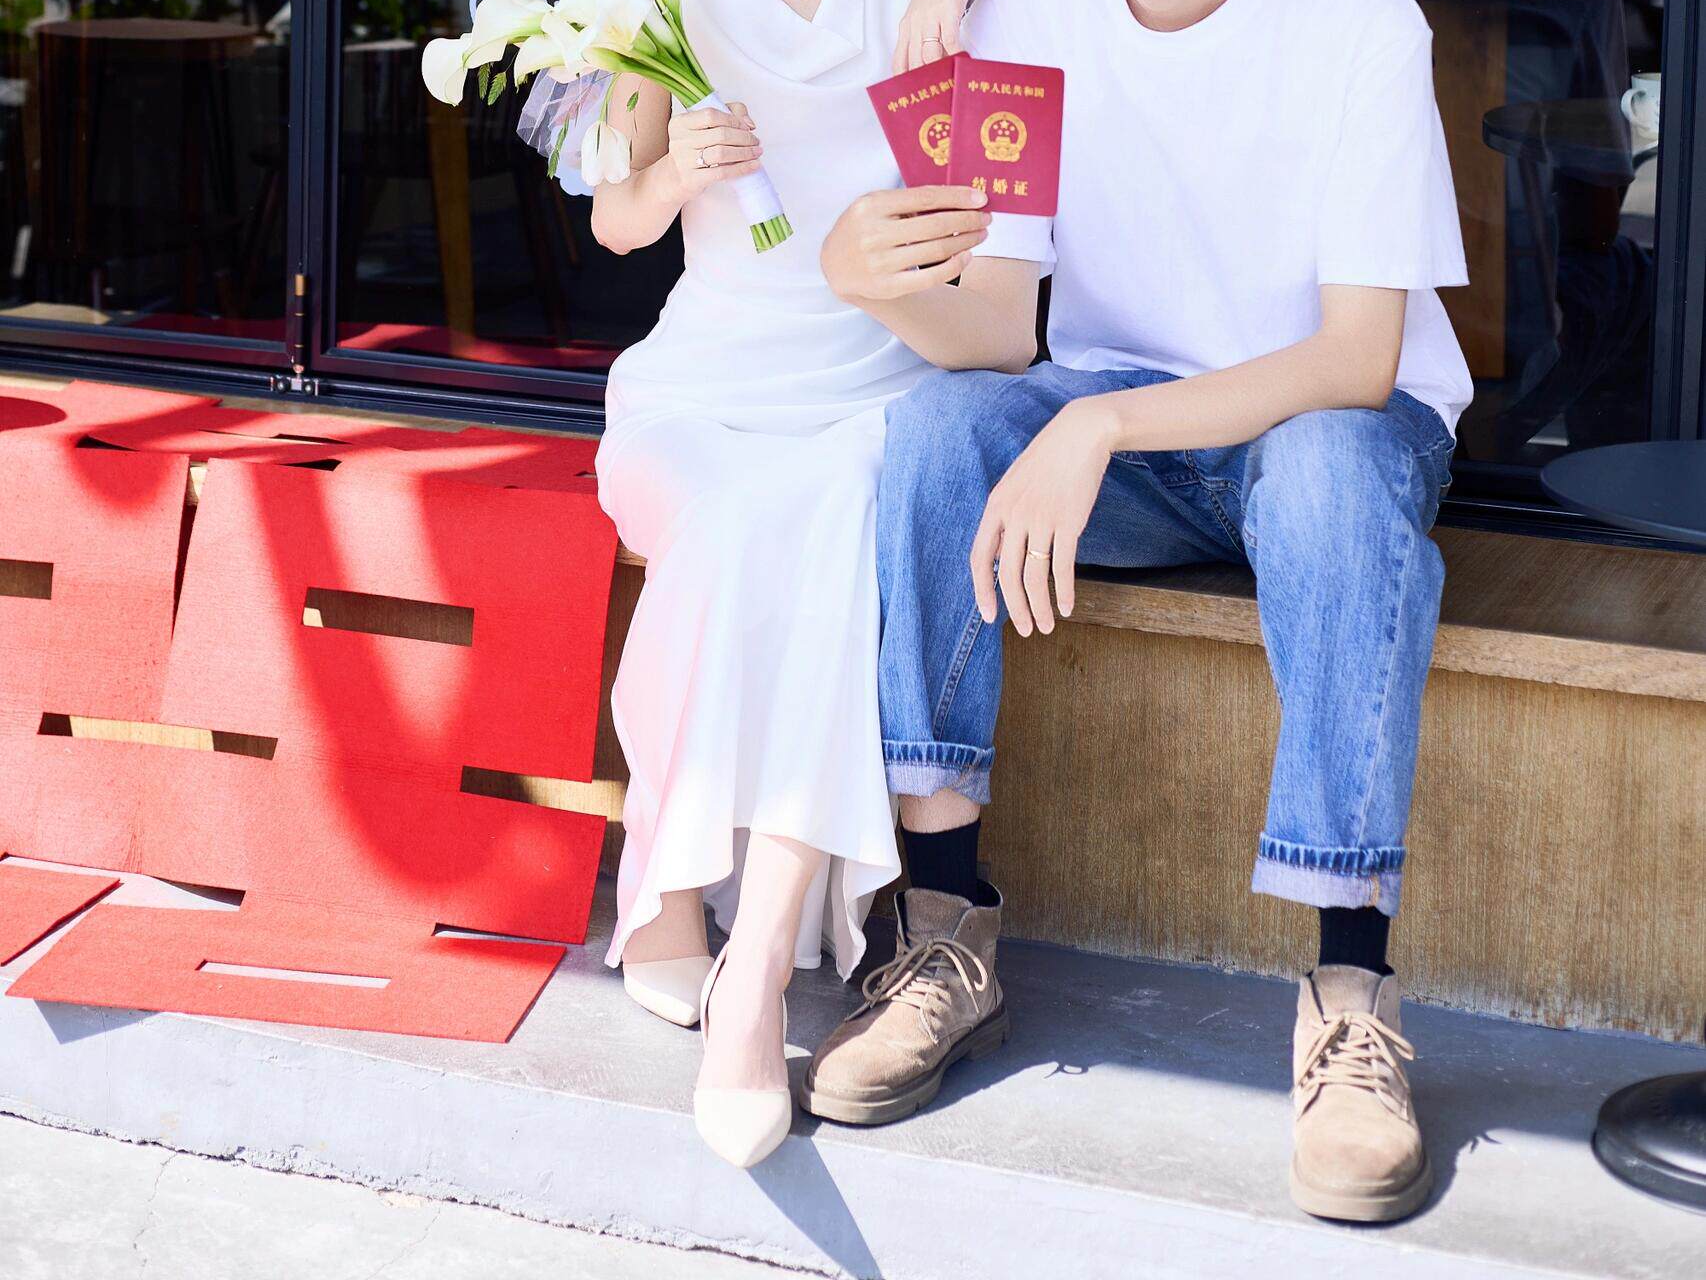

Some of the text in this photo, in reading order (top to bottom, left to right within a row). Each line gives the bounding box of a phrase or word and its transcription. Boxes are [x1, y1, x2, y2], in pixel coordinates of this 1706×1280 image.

[967, 79, 1046, 99] 中华人民共和国
